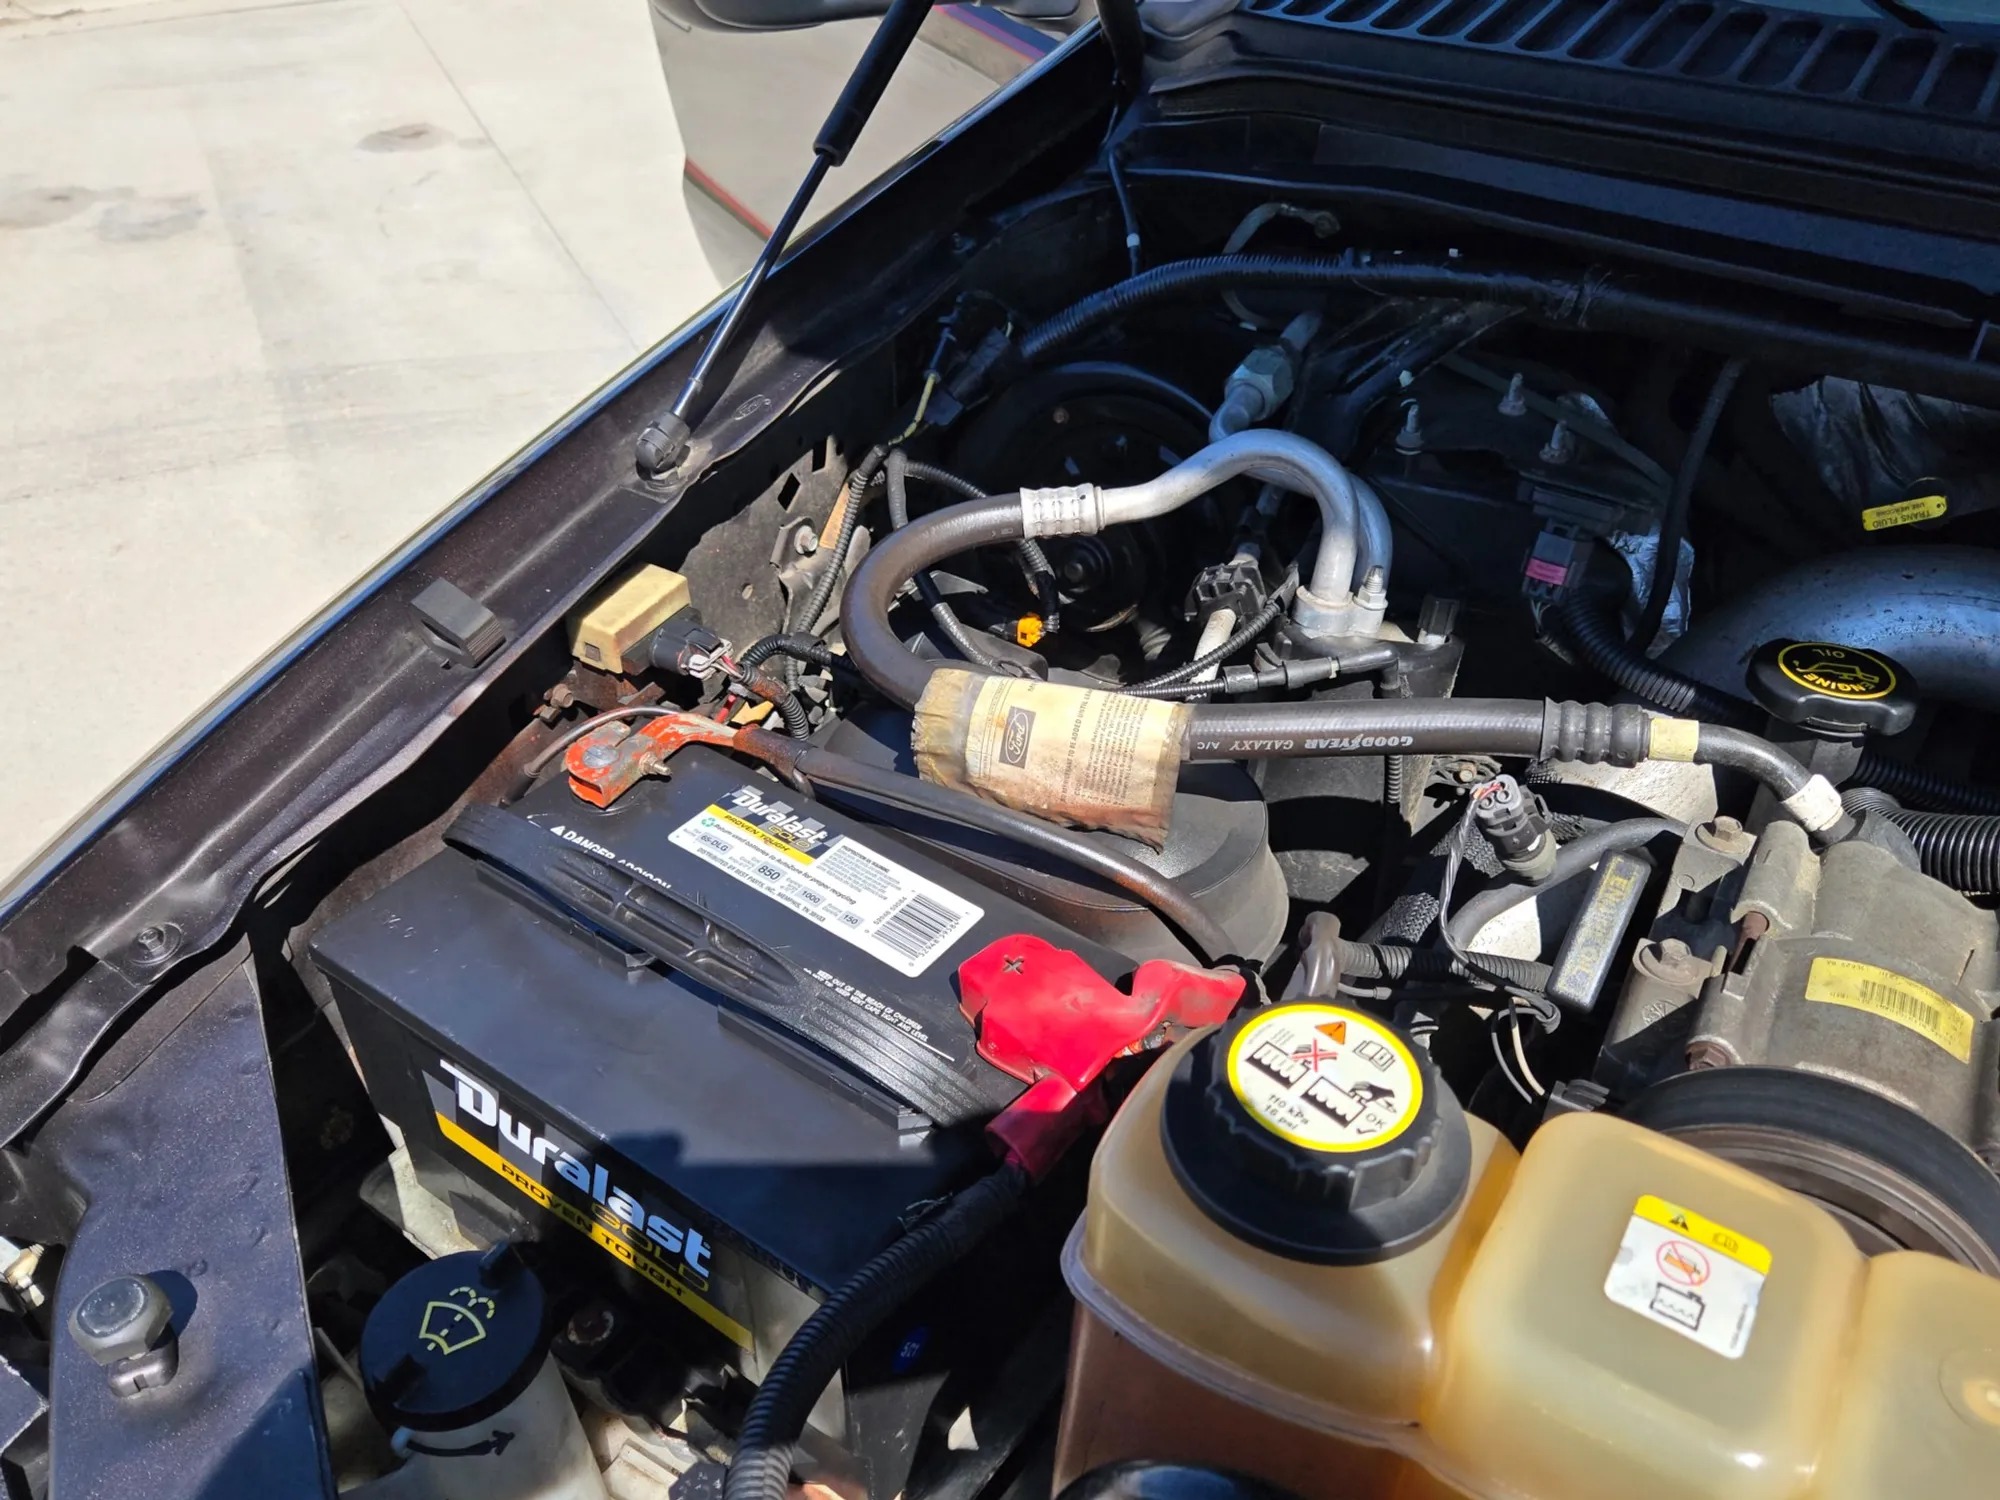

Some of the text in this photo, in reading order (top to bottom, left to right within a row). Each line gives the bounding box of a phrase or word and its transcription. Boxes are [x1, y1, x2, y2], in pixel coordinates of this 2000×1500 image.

[1872, 510, 1930, 528] TRANS FLUID
[1812, 648, 1846, 659] OIL
[1803, 672, 1876, 692] ENGINE
[1008, 722, 1025, 755] Ford
[1072, 718, 1082, 740] ADDED
[1197, 734, 1414, 751] GOODYEAR GALAXY A/C
[732, 788, 828, 844] Duralast
[700, 832, 729, 852] 65-DLG
[724, 814, 759, 836] PROVEN
[759, 833, 790, 852] TOUGH
[768, 826, 810, 848] GOLD
[758, 864, 780, 880] 850
[802, 890, 821, 904] 1000
[843, 914, 858, 925] 150
[832, 976, 846, 987] OUT
[854, 989, 866, 1000] THE
[865, 996, 884, 1010] REACH
[893, 1012, 924, 1030] CHILDREN
[850, 995, 866, 1006] VENT
[864, 1004, 881, 1016] CAPS
[880, 1012, 899, 1024] TIGHT
[897, 1021, 912, 1034] AND
[910, 1029, 929, 1042] LEVEL
[1265, 1104, 1278, 1116] 16
[1288, 1106, 1310, 1125] kPa
[1366, 1113, 1387, 1128] OK
[440, 1058, 712, 1278] Duralast
[502, 1162, 686, 1297] PROVEN TOUGH
[590, 1203, 710, 1293] GOLD
